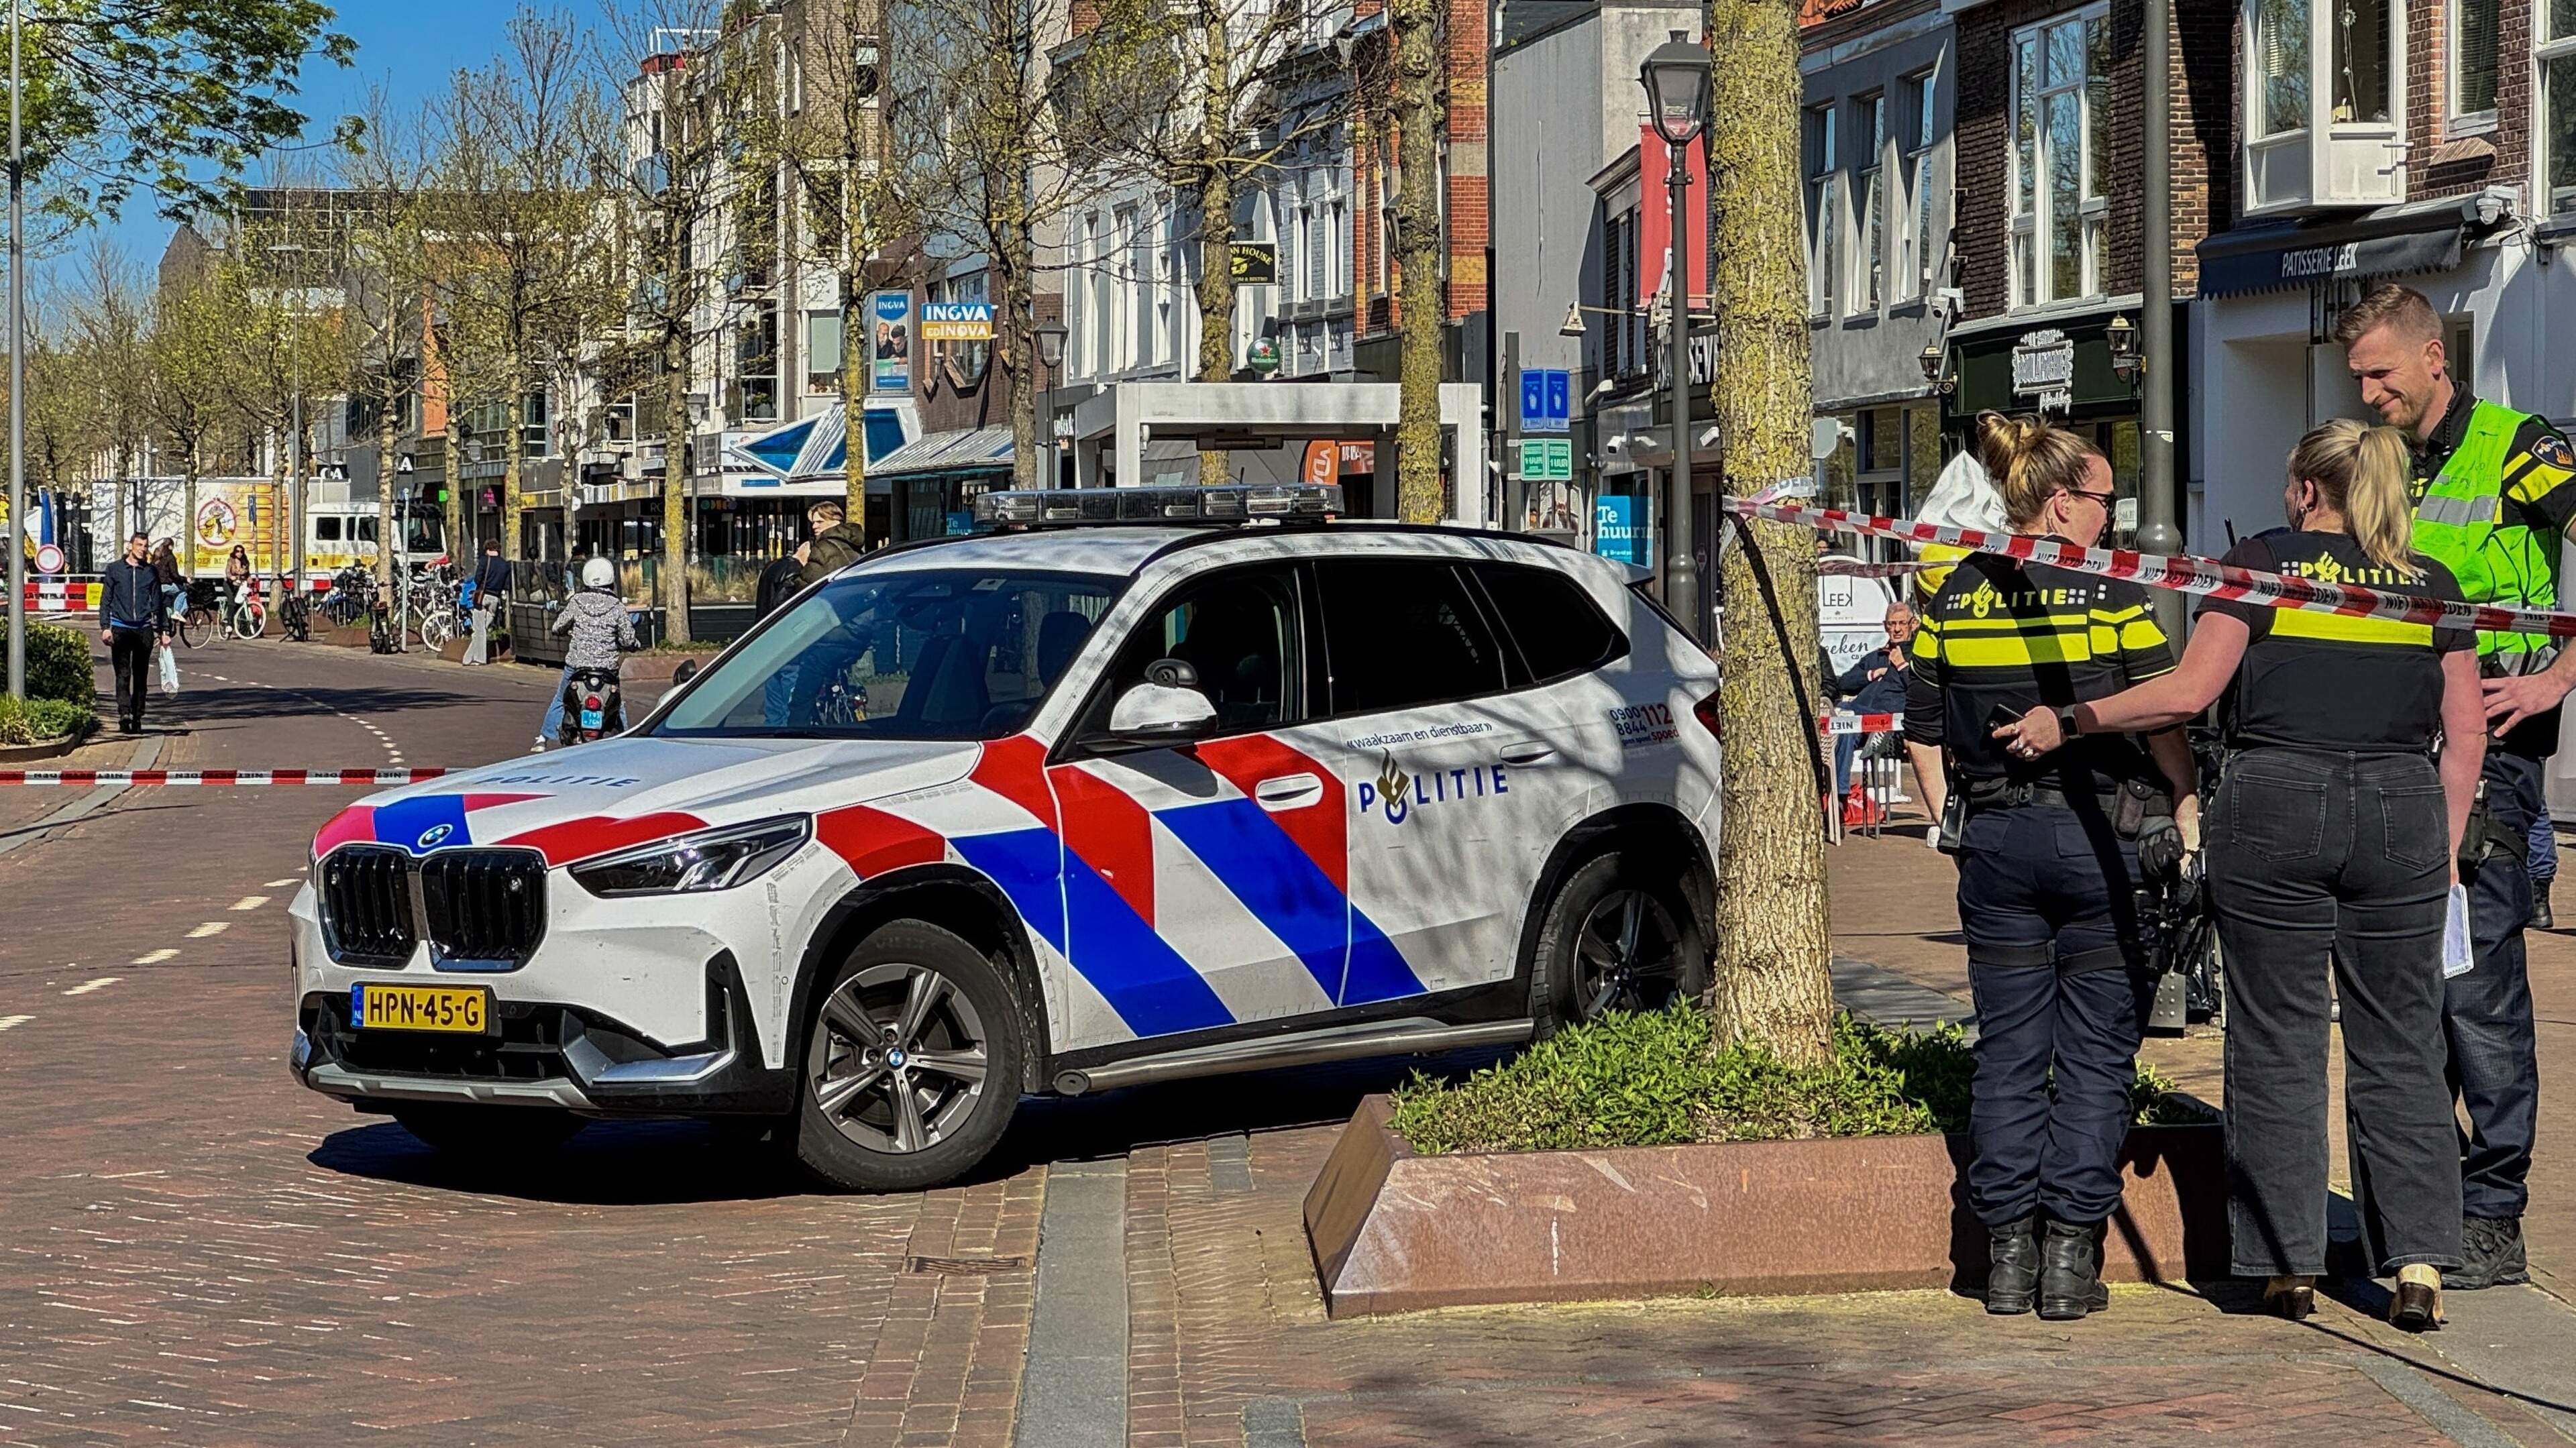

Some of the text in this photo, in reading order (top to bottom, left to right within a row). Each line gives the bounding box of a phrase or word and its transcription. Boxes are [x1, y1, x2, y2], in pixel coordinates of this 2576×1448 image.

[1242, 246, 1273, 266] HOUSE
[2282, 242, 2359, 278] PATISSERIE LEEK
[878, 301, 906, 310] INOVA
[926, 305, 989, 321] INOVA
[1597, 505, 1618, 524] Te
[2139, 566, 2166, 581] NIET
[2166, 570, 2217, 590] BETREDEN
[2257, 580, 2282, 597] NIET
[1960, 588, 2068, 618] POLITIE
[2385, 594, 2410, 610] NIET
[1609, 706, 1641, 721] 0900
[1641, 704, 1674, 726] 112
[1615, 720, 1647, 736] 8844
[1829, 720, 1854, 730] NIET
[1414, 730, 1430, 740] en
[1651, 725, 1680, 743] spoed
[472, 775, 641, 787] POLITIE
[1358, 764, 1509, 825] POLITIE
[354, 1010, 364, 1021] NL
[370, 991, 479, 1027] HPN-45-G
